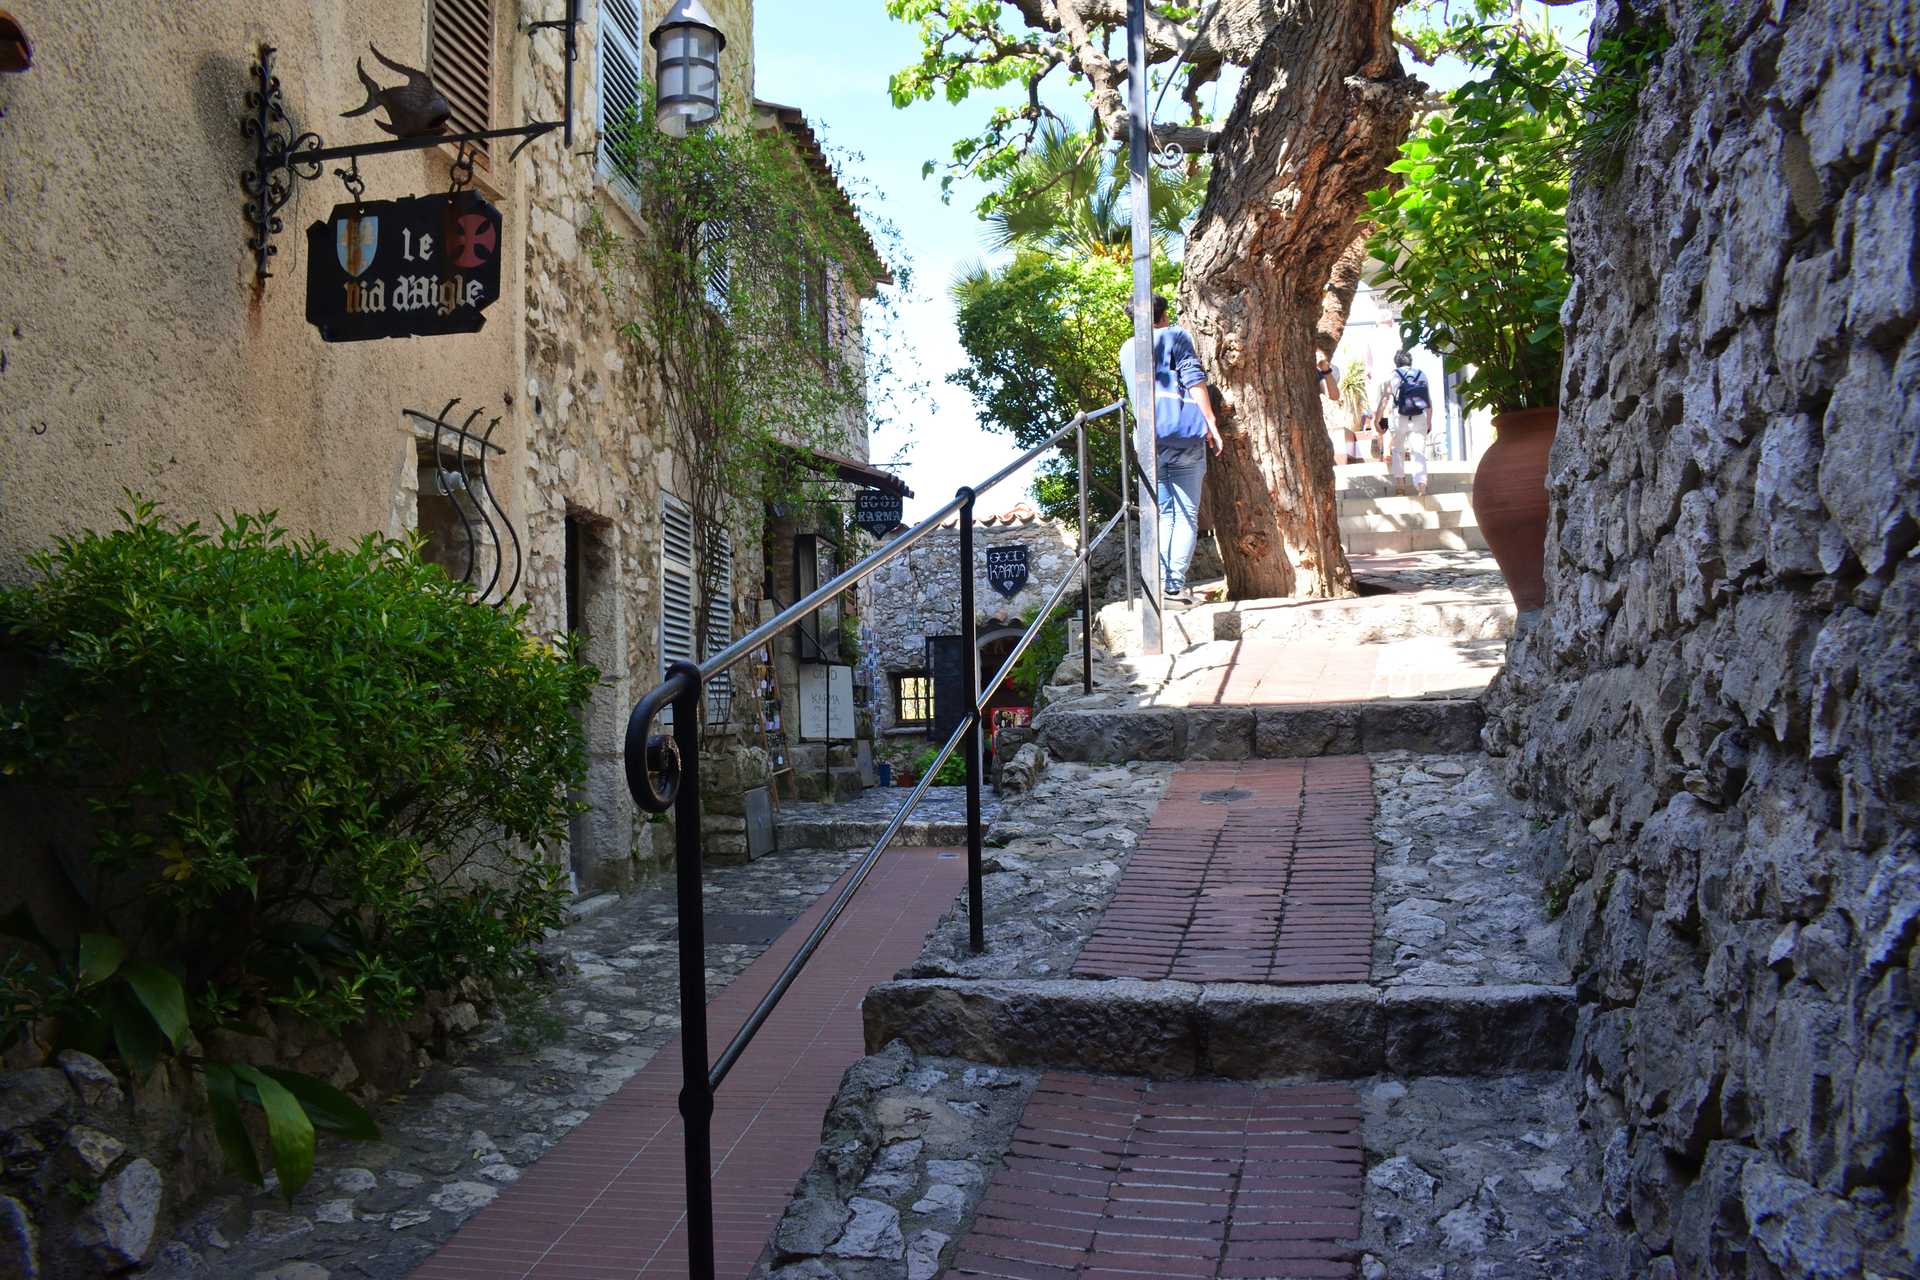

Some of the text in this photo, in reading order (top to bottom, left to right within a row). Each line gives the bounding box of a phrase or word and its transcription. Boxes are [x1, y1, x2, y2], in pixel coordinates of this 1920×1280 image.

[858, 511, 901, 521] KARMA
[990, 550, 1025, 563] GOOD
[989, 563, 1026, 580] KARMA
